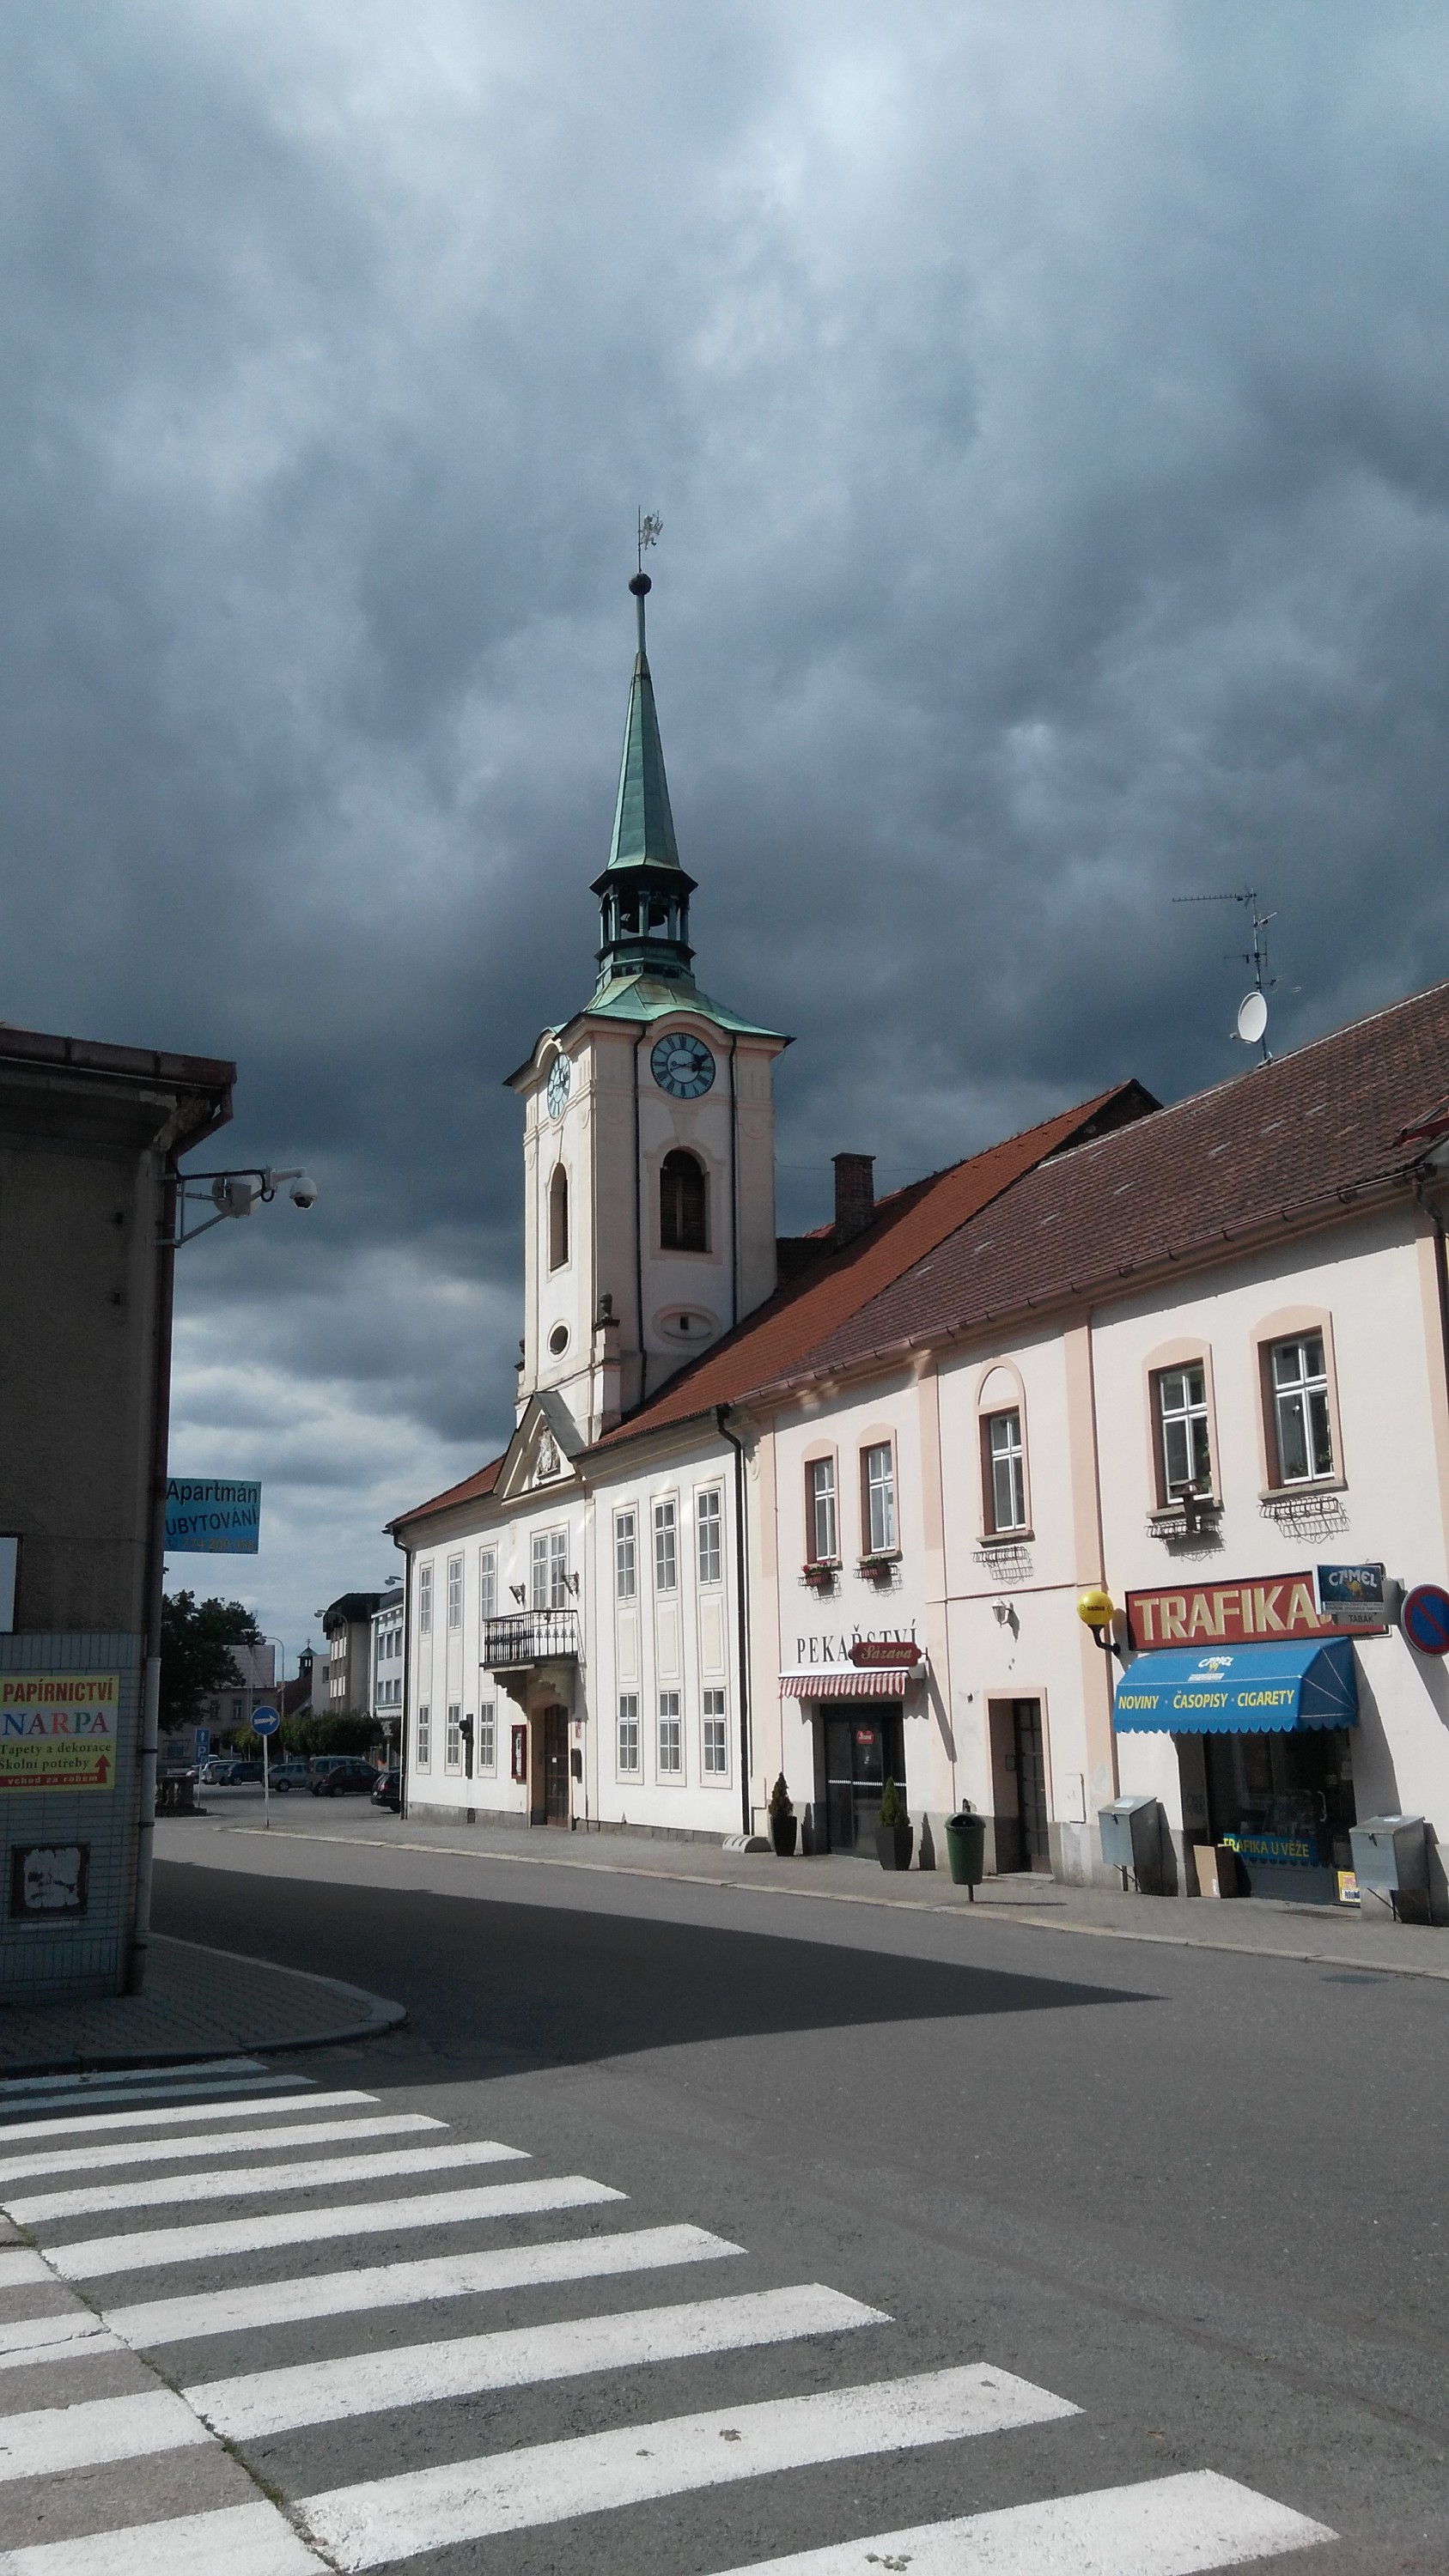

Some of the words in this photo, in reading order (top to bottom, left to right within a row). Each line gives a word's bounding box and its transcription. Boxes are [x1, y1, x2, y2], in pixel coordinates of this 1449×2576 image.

[167, 1479, 258, 1505] Apartmán
[165, 1504, 257, 1535] UBYTOVÁNÍ
[1329, 1570, 1378, 1588] CAMEL
[1134, 1583, 1320, 1640] TRAFIKA
[861, 1644, 912, 1660] Sázava
[1198, 1656, 1234, 1668] CAMEL
[3, 1678, 113, 1702] PAPÍRNICTVÍ
[1118, 1695, 1160, 1710] NOVINY
[1173, 1690, 1229, 1709] ČASOPISY
[1237, 1690, 1295, 1707] CIGARETY
[3, 1711, 110, 1735] NARPA
[0, 1744, 42, 1758] Tapety
[58, 1742, 112, 1753] dekorace
[0, 1758, 38, 1770] Školní
[42, 1758, 89, 1771] potřeby
[64, 1774, 98, 1783] rohem
[1223, 1838, 1269, 1855] TRAFIKA
[1271, 1842, 1279, 1855] U
[1281, 1840, 1310, 1858] VĚŽE
